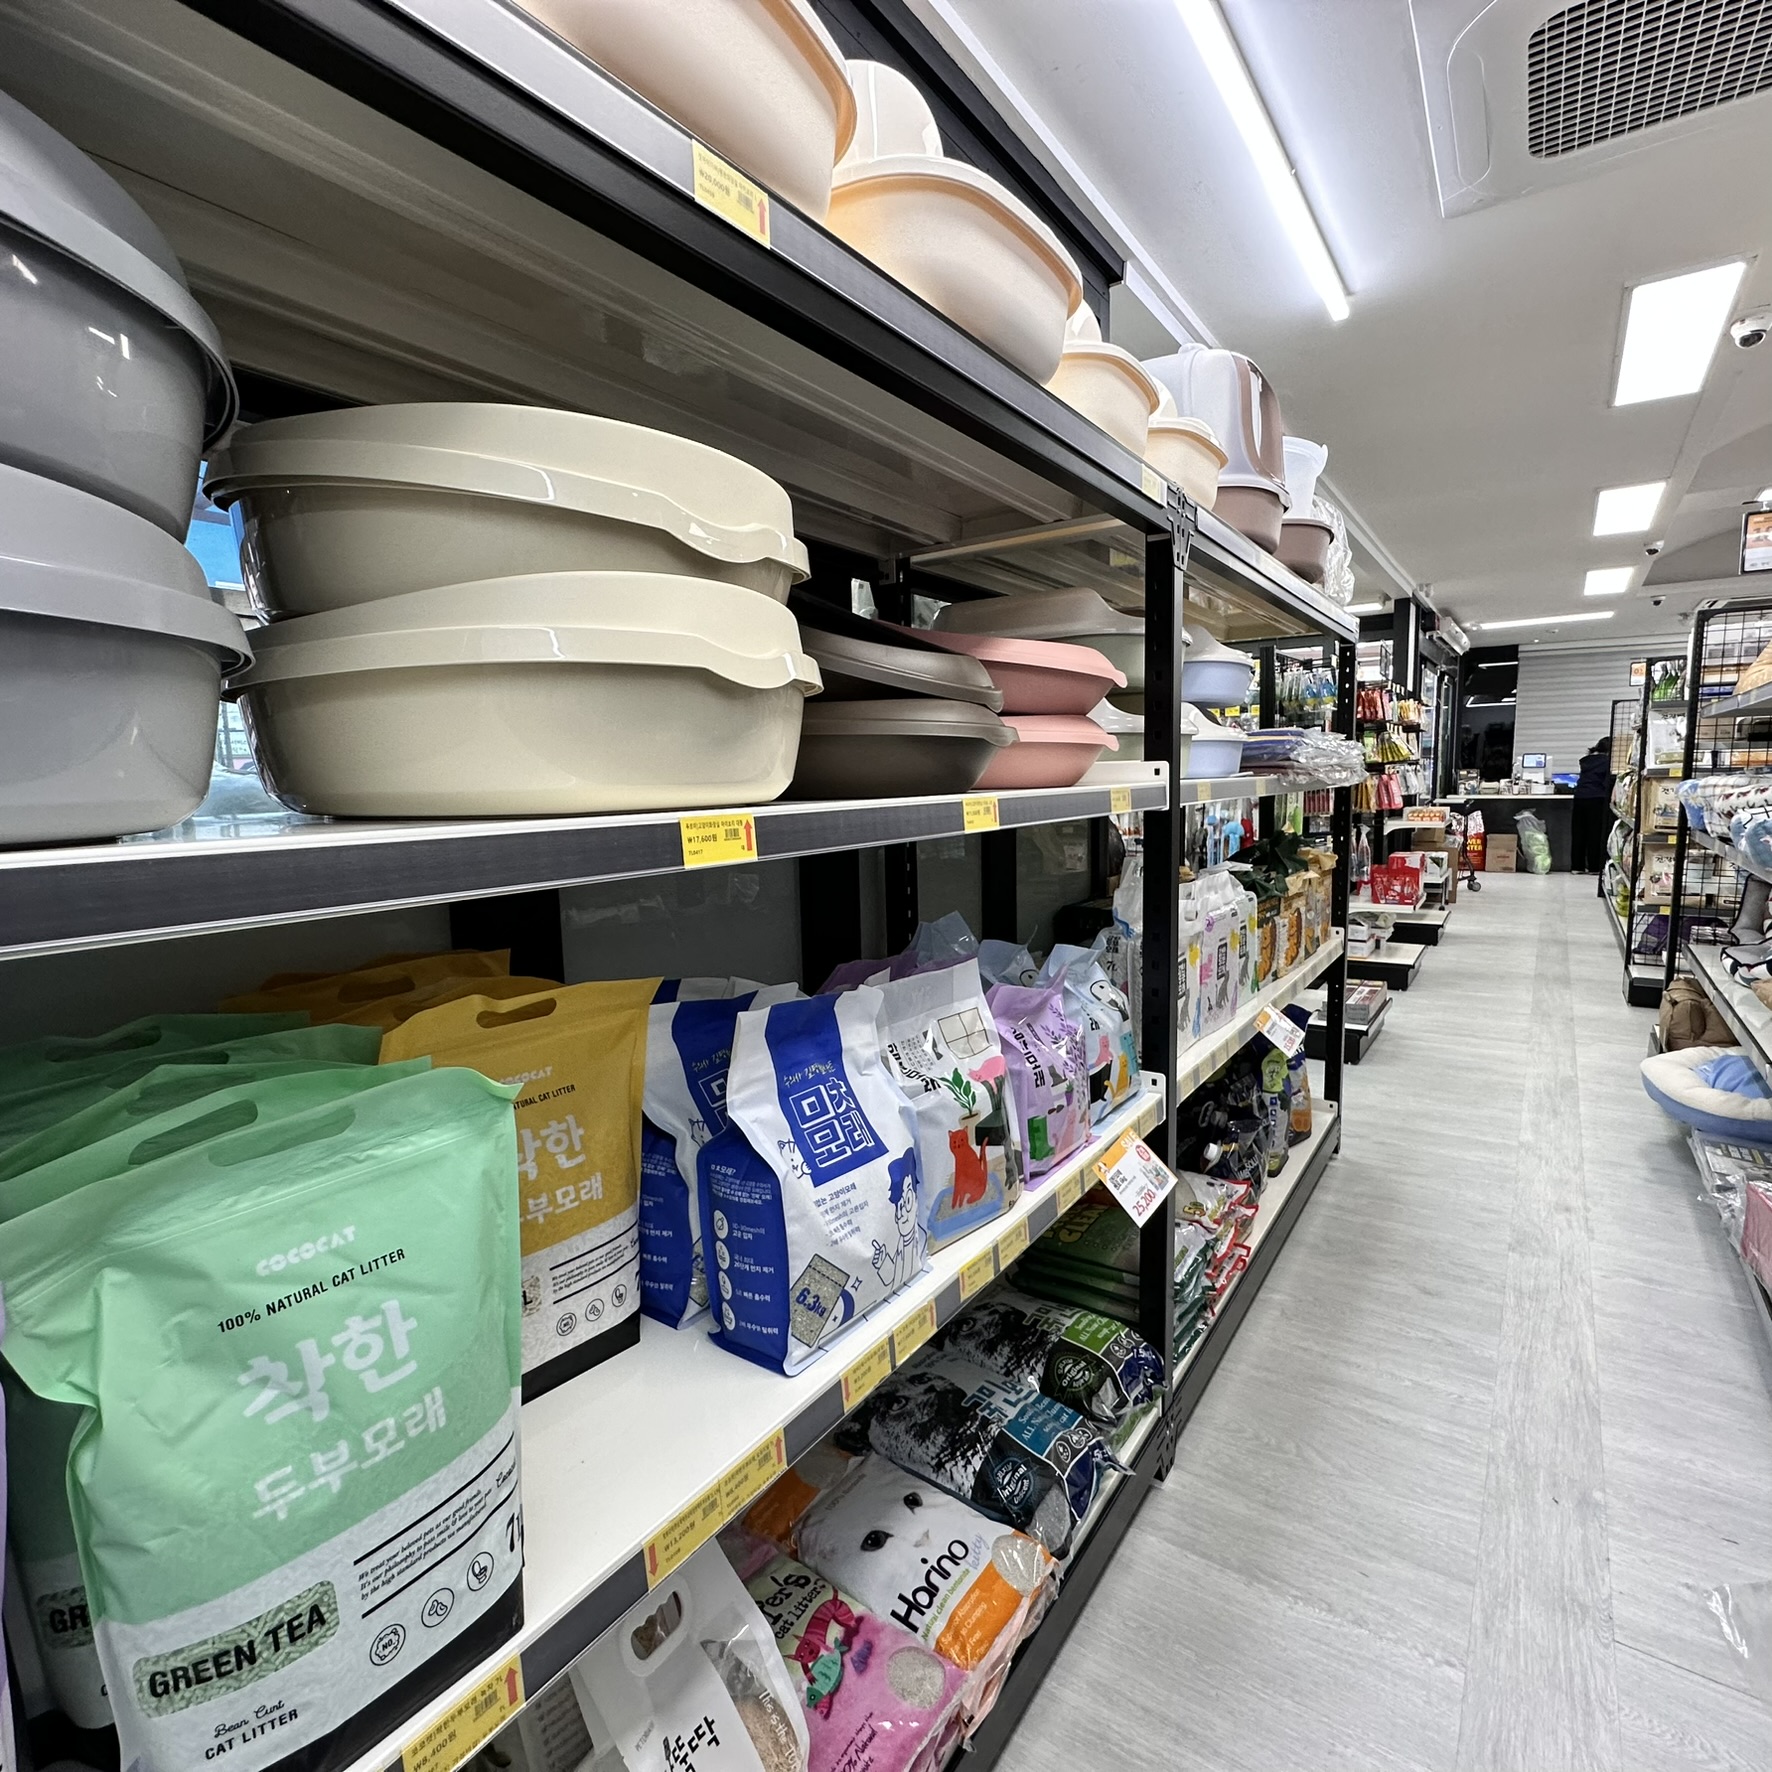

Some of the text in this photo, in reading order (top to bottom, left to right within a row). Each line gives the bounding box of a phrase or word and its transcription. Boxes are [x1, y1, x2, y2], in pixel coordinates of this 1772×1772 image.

[1106, 961, 1118, 972] 7L
[539, 1091, 551, 1103] CAT
[552, 1084, 576, 1099] LITTER
[520, 1172, 604, 1225] 부모래
[1133, 1188, 1157, 1217] 25,200
[256, 1225, 356, 1277] COCOCAT
[217, 1248, 406, 1333] 100% NATURAL CAT LITTER
[796, 1287, 827, 1317] 6.3kg
[237, 1299, 418, 1425] 착한
[253, 1386, 447, 1521] 두부모래
[890, 1539, 969, 1634] Harino
[921, 1568, 971, 1642] Natural clean bentonite
[149, 1603, 327, 1698] GREEN TEA
[774, 1620, 795, 1640] cat
[758, 1688, 774, 1714] This
[770, 1713, 781, 1726] is
[204, 1708, 300, 1761] CAT LITTER
[214, 1719, 250, 1739] Bean
[775, 1723, 790, 1743] the
